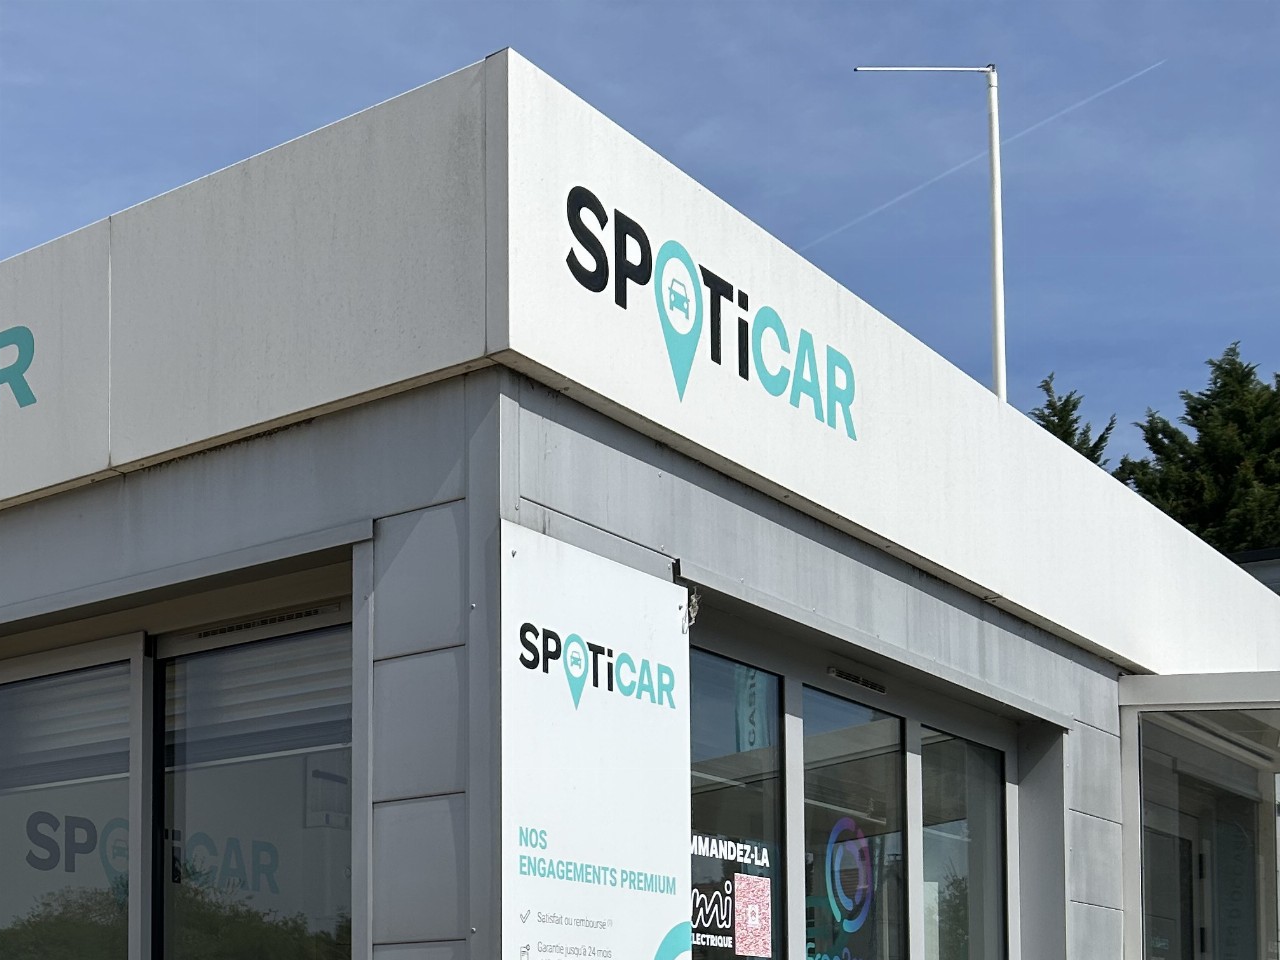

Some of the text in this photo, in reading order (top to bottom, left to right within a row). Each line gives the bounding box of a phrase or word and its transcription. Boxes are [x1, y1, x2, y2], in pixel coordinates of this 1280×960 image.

[519, 826, 548, 850] NOS
[519, 854, 677, 896] ENGAGEMENTS PREMIUM
[537, 911, 563, 926] Satisfait
[565, 916, 572, 926] ou
[574, 916, 606, 930] remboursé
[538, 941, 564, 954] Garantie
[588, 946, 596, 956] 24
[596, 946, 612, 958] mois
[692, 932, 732, 948] LECTRIQUE
